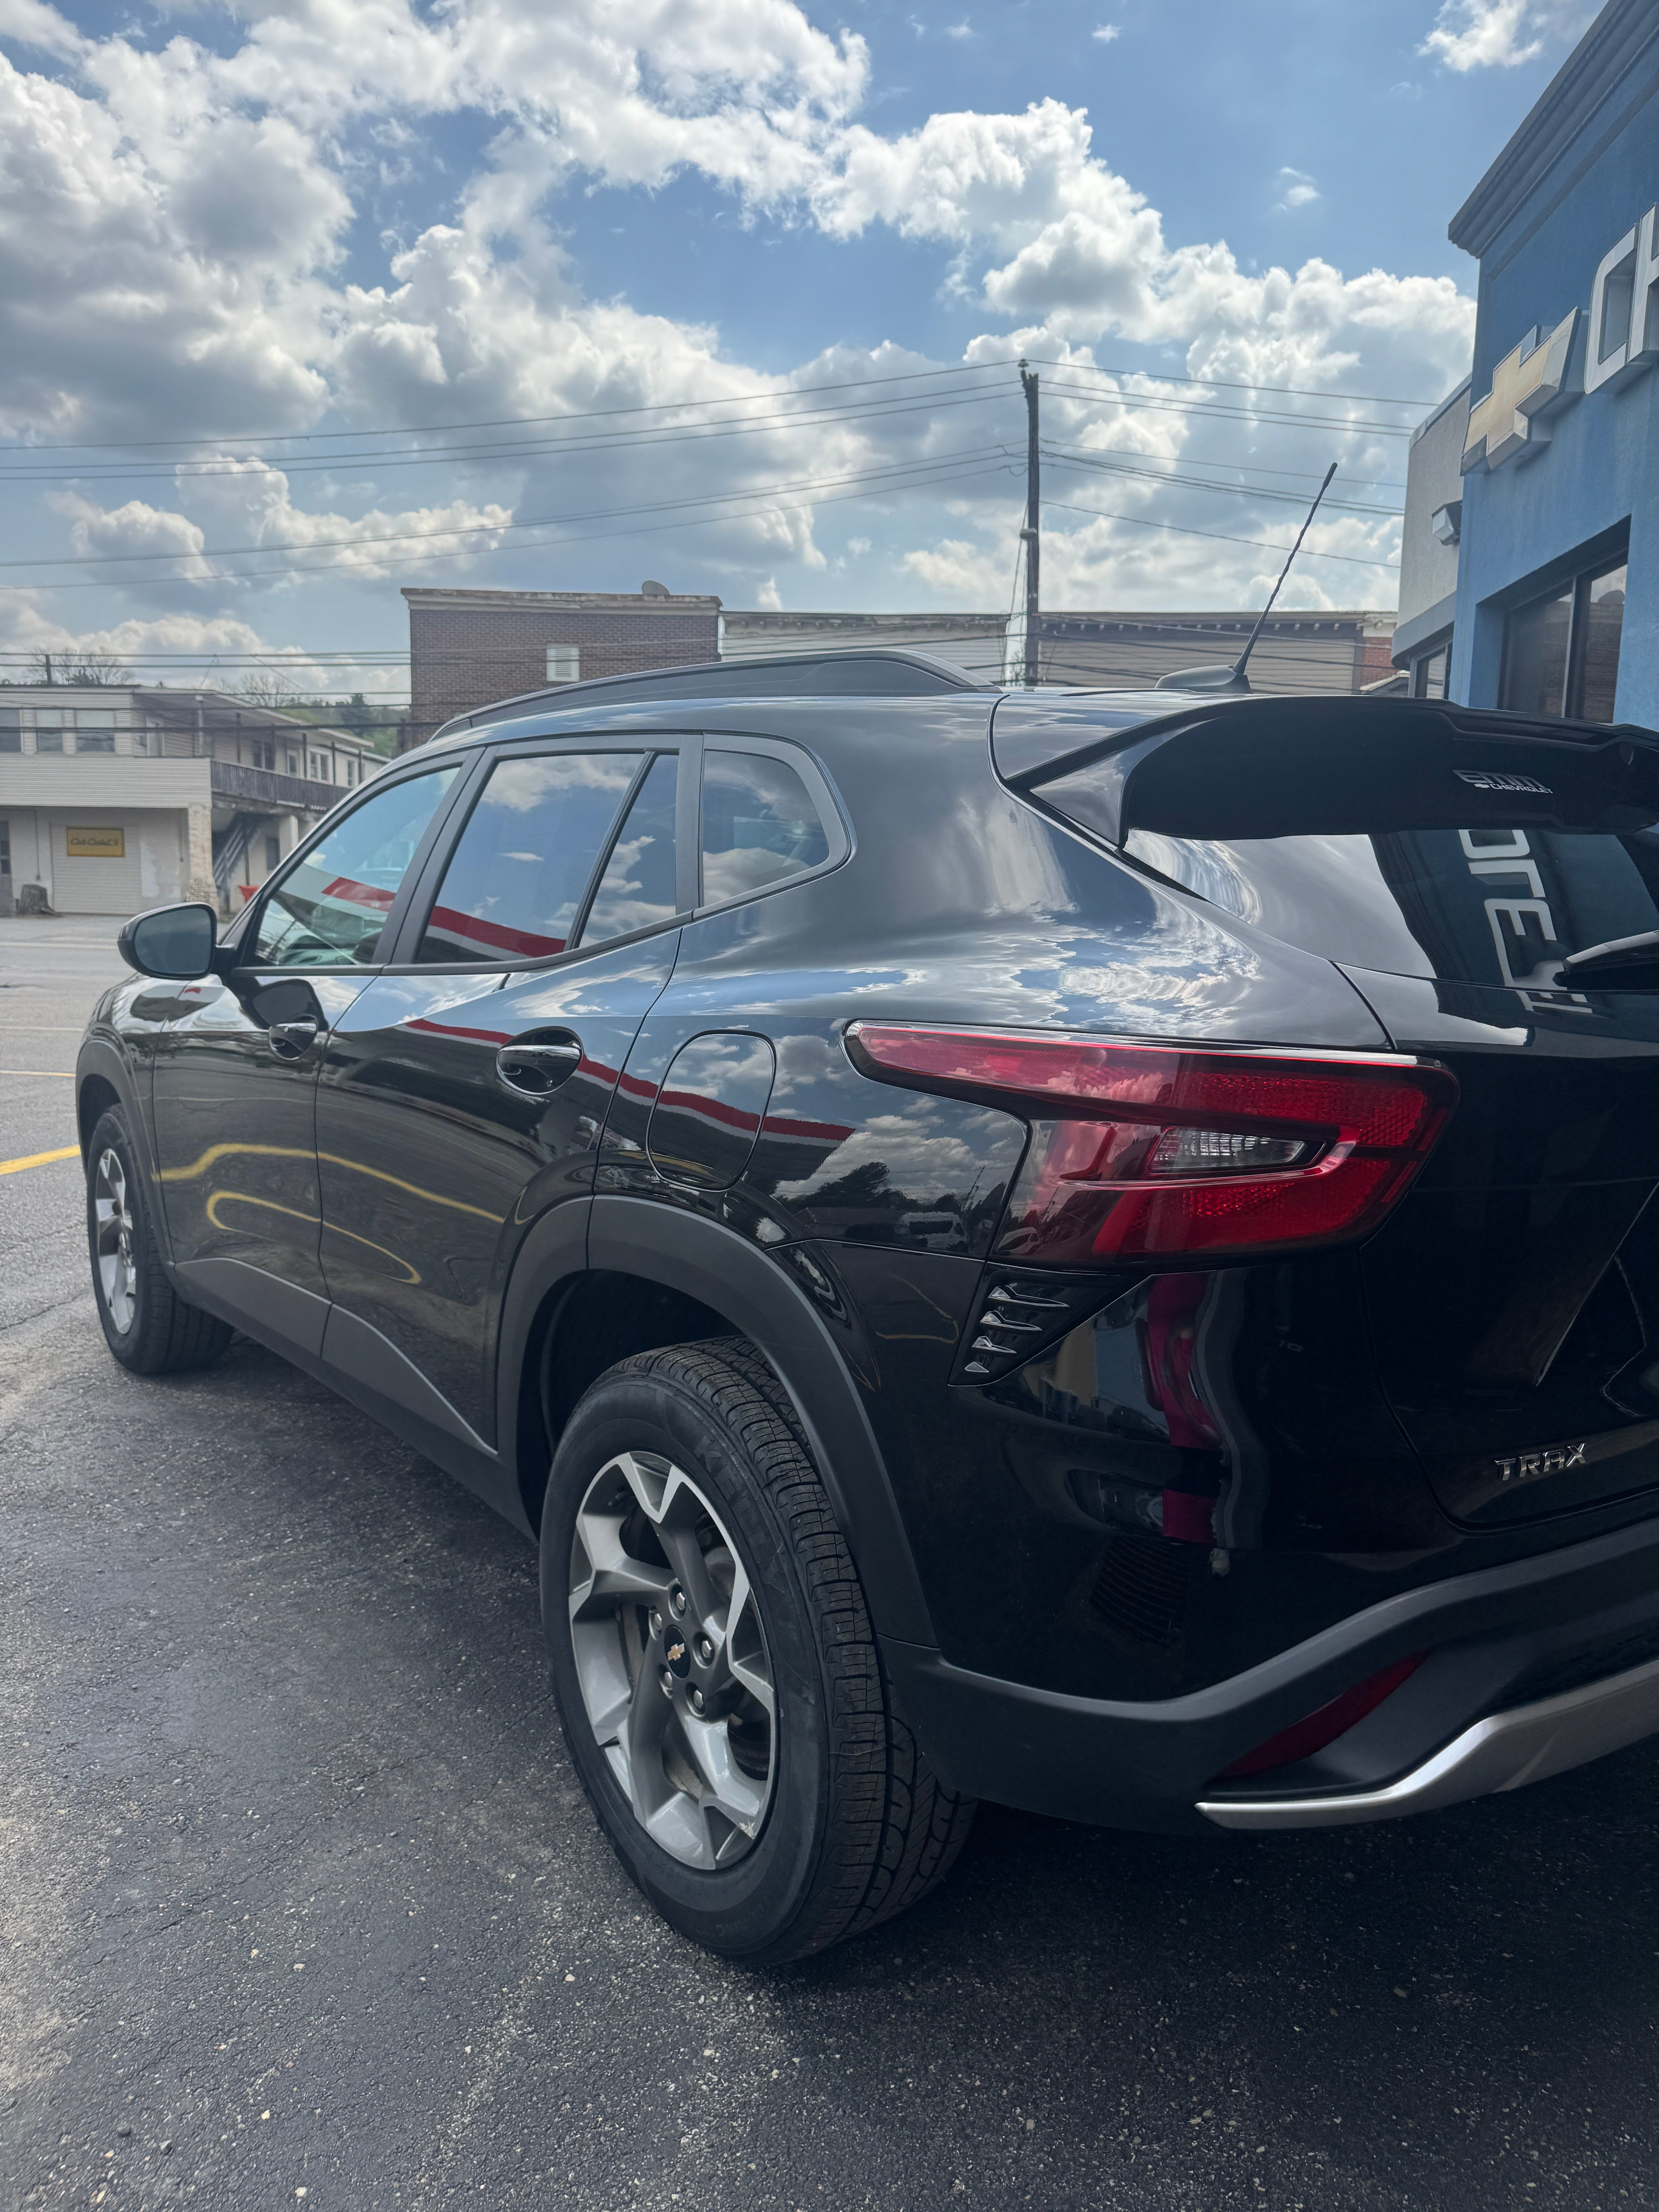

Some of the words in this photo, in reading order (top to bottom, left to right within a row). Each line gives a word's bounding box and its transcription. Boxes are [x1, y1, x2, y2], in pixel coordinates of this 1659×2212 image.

[1490, 783, 1553, 794] CHEVROLET
[1494, 1443, 1587, 1481] TRAX
[693, 1434, 786, 1595] KELLY
